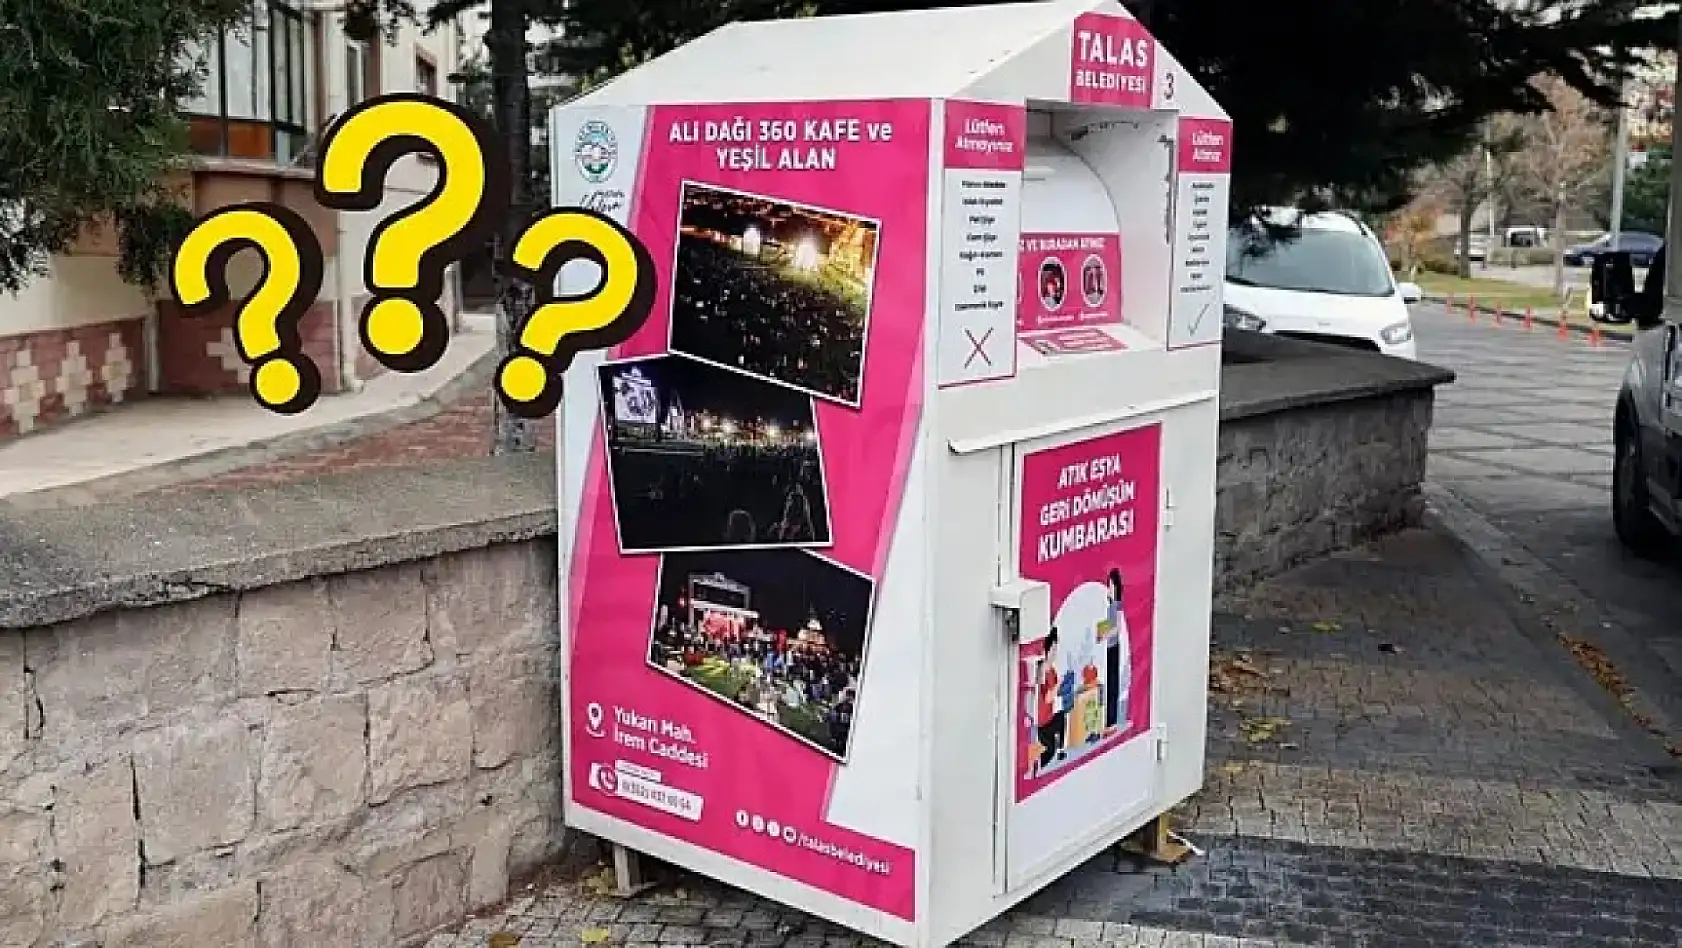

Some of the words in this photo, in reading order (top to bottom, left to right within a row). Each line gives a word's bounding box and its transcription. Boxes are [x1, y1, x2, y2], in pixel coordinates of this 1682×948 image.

[1077, 29, 1148, 68] TALAS
[1163, 72, 1175, 100] 3
[704, 116, 751, 142] DAĞI
[758, 120, 797, 141] 360
[803, 118, 861, 142] KAFE
[867, 121, 893, 141] ve
[716, 144, 771, 172] YEŞİL
[777, 147, 836, 170] ALAN
[1057, 460, 1089, 489] ATIK
[1040, 497, 1071, 526] GERİ
[1073, 479, 1136, 517] DÖNÜŞÜM
[1037, 508, 1135, 563] KUMBARASI
[660, 719, 697, 744] Mah.
[649, 737, 709, 768] Caddesi
